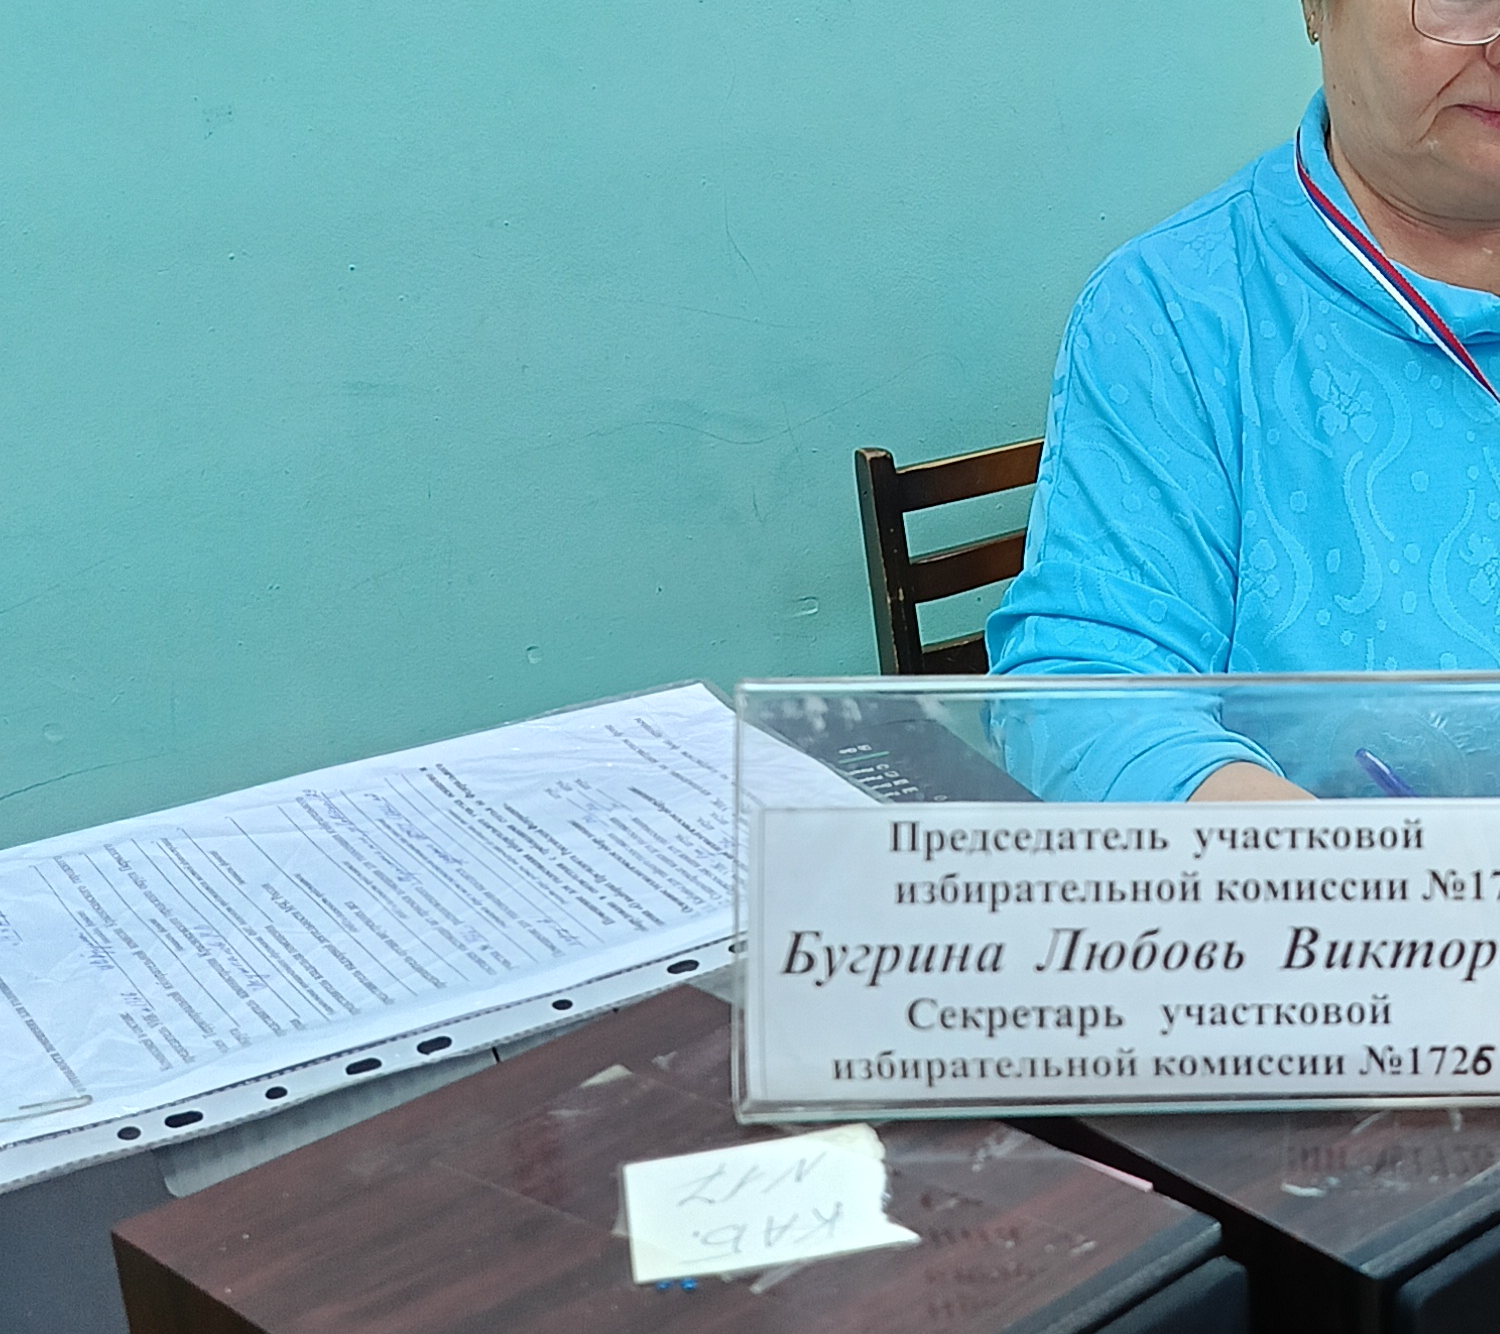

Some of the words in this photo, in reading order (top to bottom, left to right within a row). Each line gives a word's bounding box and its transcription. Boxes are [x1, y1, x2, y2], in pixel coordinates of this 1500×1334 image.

[889, 819, 1170, 861] Председатель
[1192, 817, 1425, 859] участковой
[894, 871, 1201, 913] избирательной
[1215, 876, 1409, 903] комиссии
[780, 929, 1007, 988] Бугрина
[1034, 926, 1246, 975] Любовь
[906, 997, 1127, 1039] Секретарь
[1159, 994, 1392, 1036] участковой
[831, 1048, 1138, 1088] избирательной
[1152, 1052, 1346, 1078] комиссии
[1359, 1044, 1497, 1076] №1726
